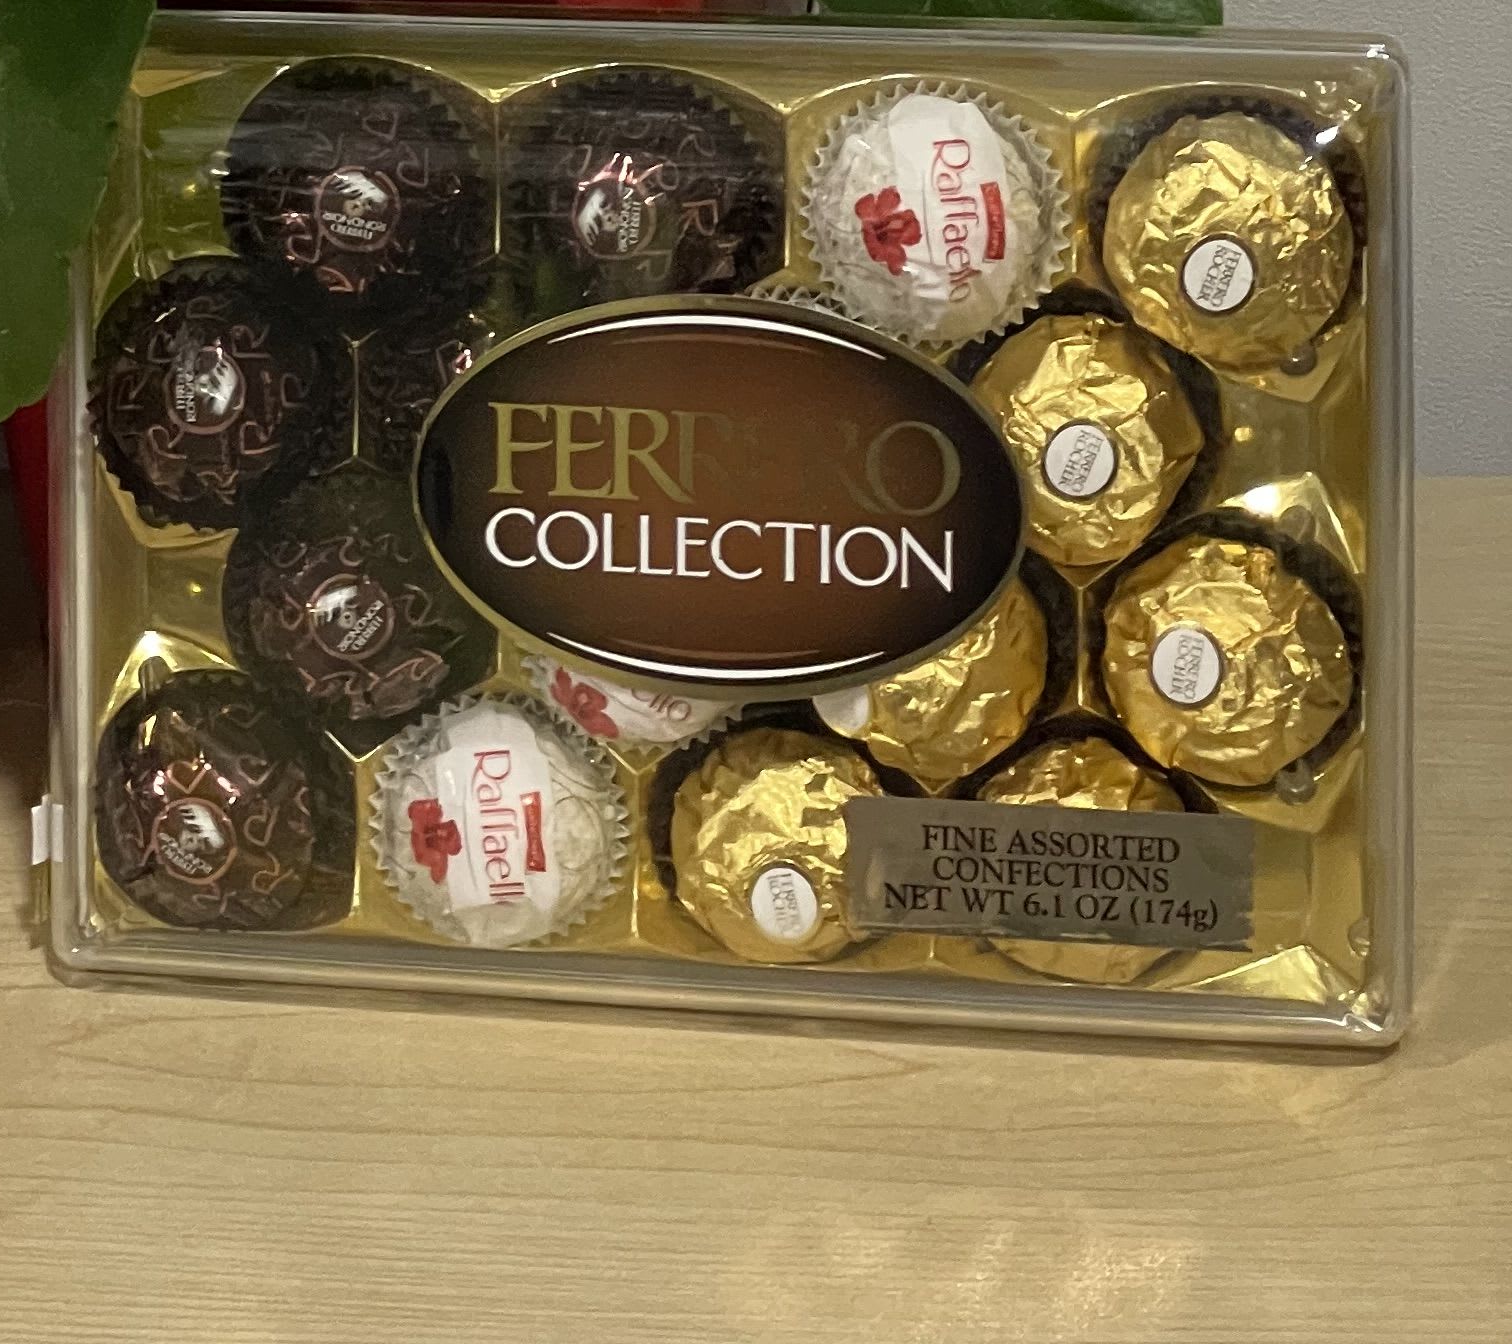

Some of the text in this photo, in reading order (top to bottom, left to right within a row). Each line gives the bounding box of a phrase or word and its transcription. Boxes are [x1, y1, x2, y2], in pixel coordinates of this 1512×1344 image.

[487, 401, 962, 518] FERRO
[484, 506, 955, 593] COLLECTION
[471, 749, 526, 904] Raffaell
[921, 823, 1181, 864] FINE ASSORTED
[883, 881, 1219, 933] NET WT 6.1 OZ (174g)
[932, 855, 1170, 893] CONFECTIONS
